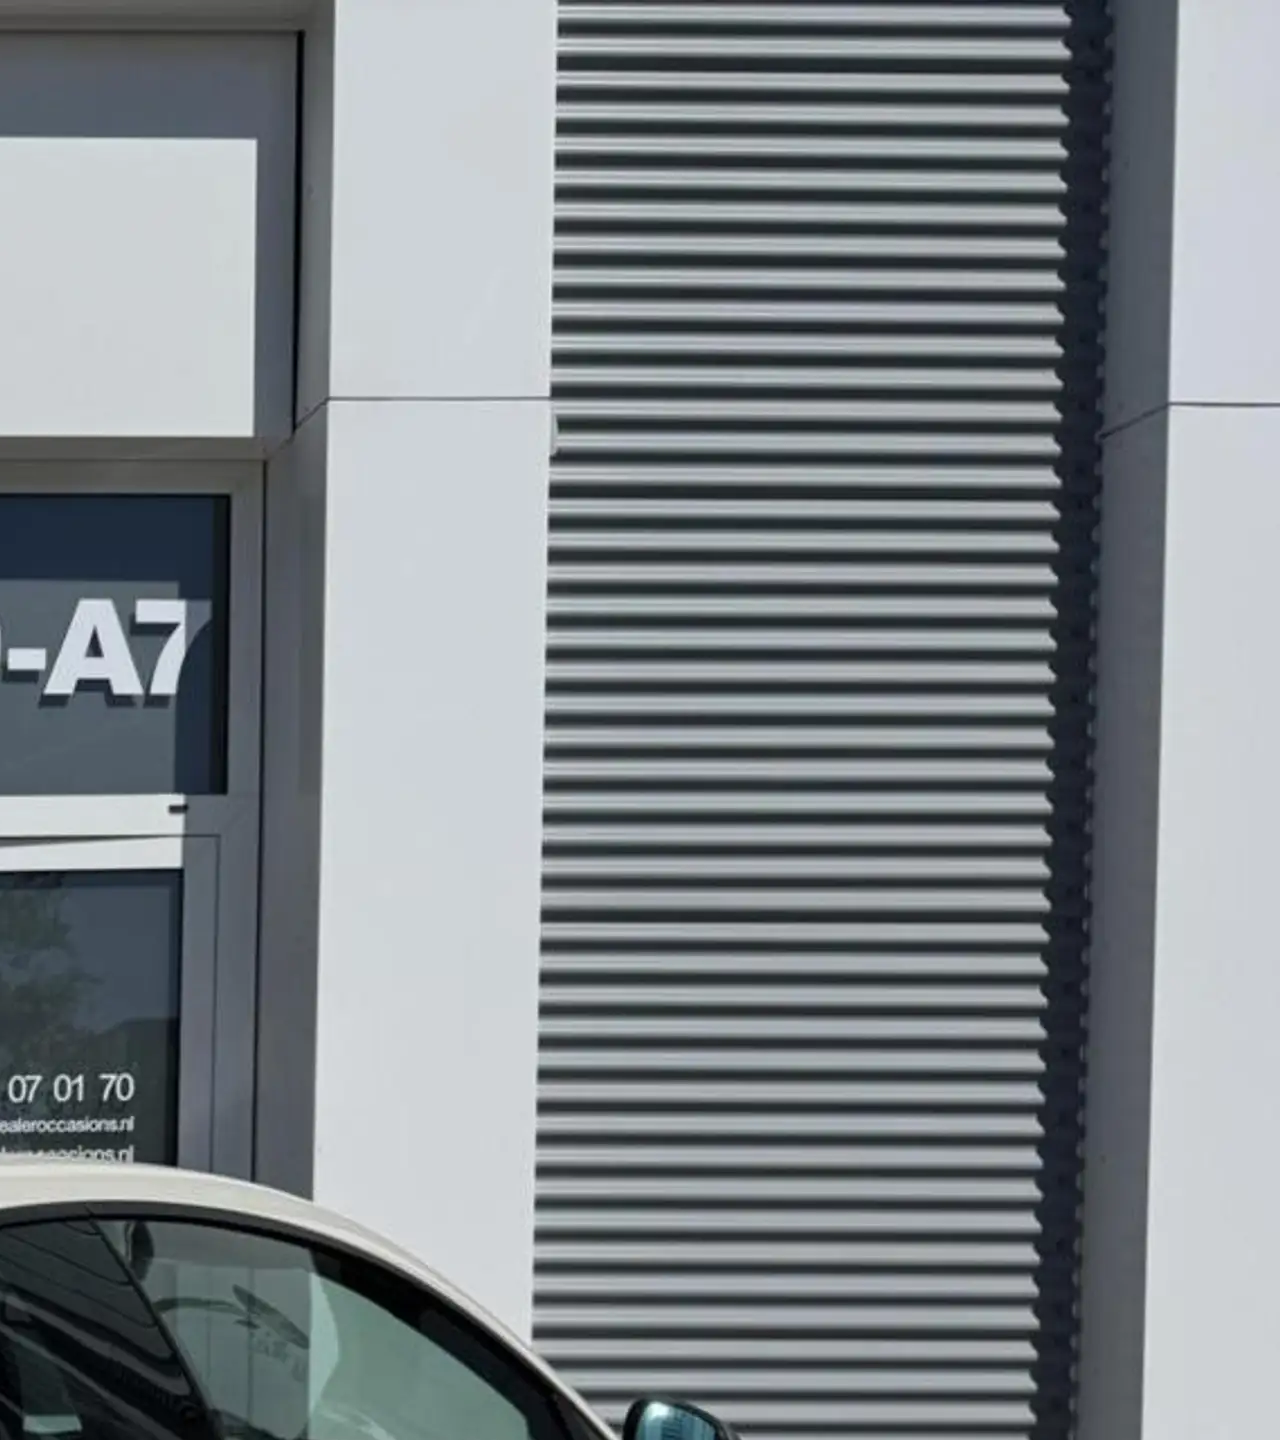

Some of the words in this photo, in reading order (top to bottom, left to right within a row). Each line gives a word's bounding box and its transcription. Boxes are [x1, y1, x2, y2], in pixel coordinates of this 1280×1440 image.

[7, 1074, 42, 1103] 07
[53, 1074, 84, 1102] 01
[99, 1072, 135, 1102] 70
